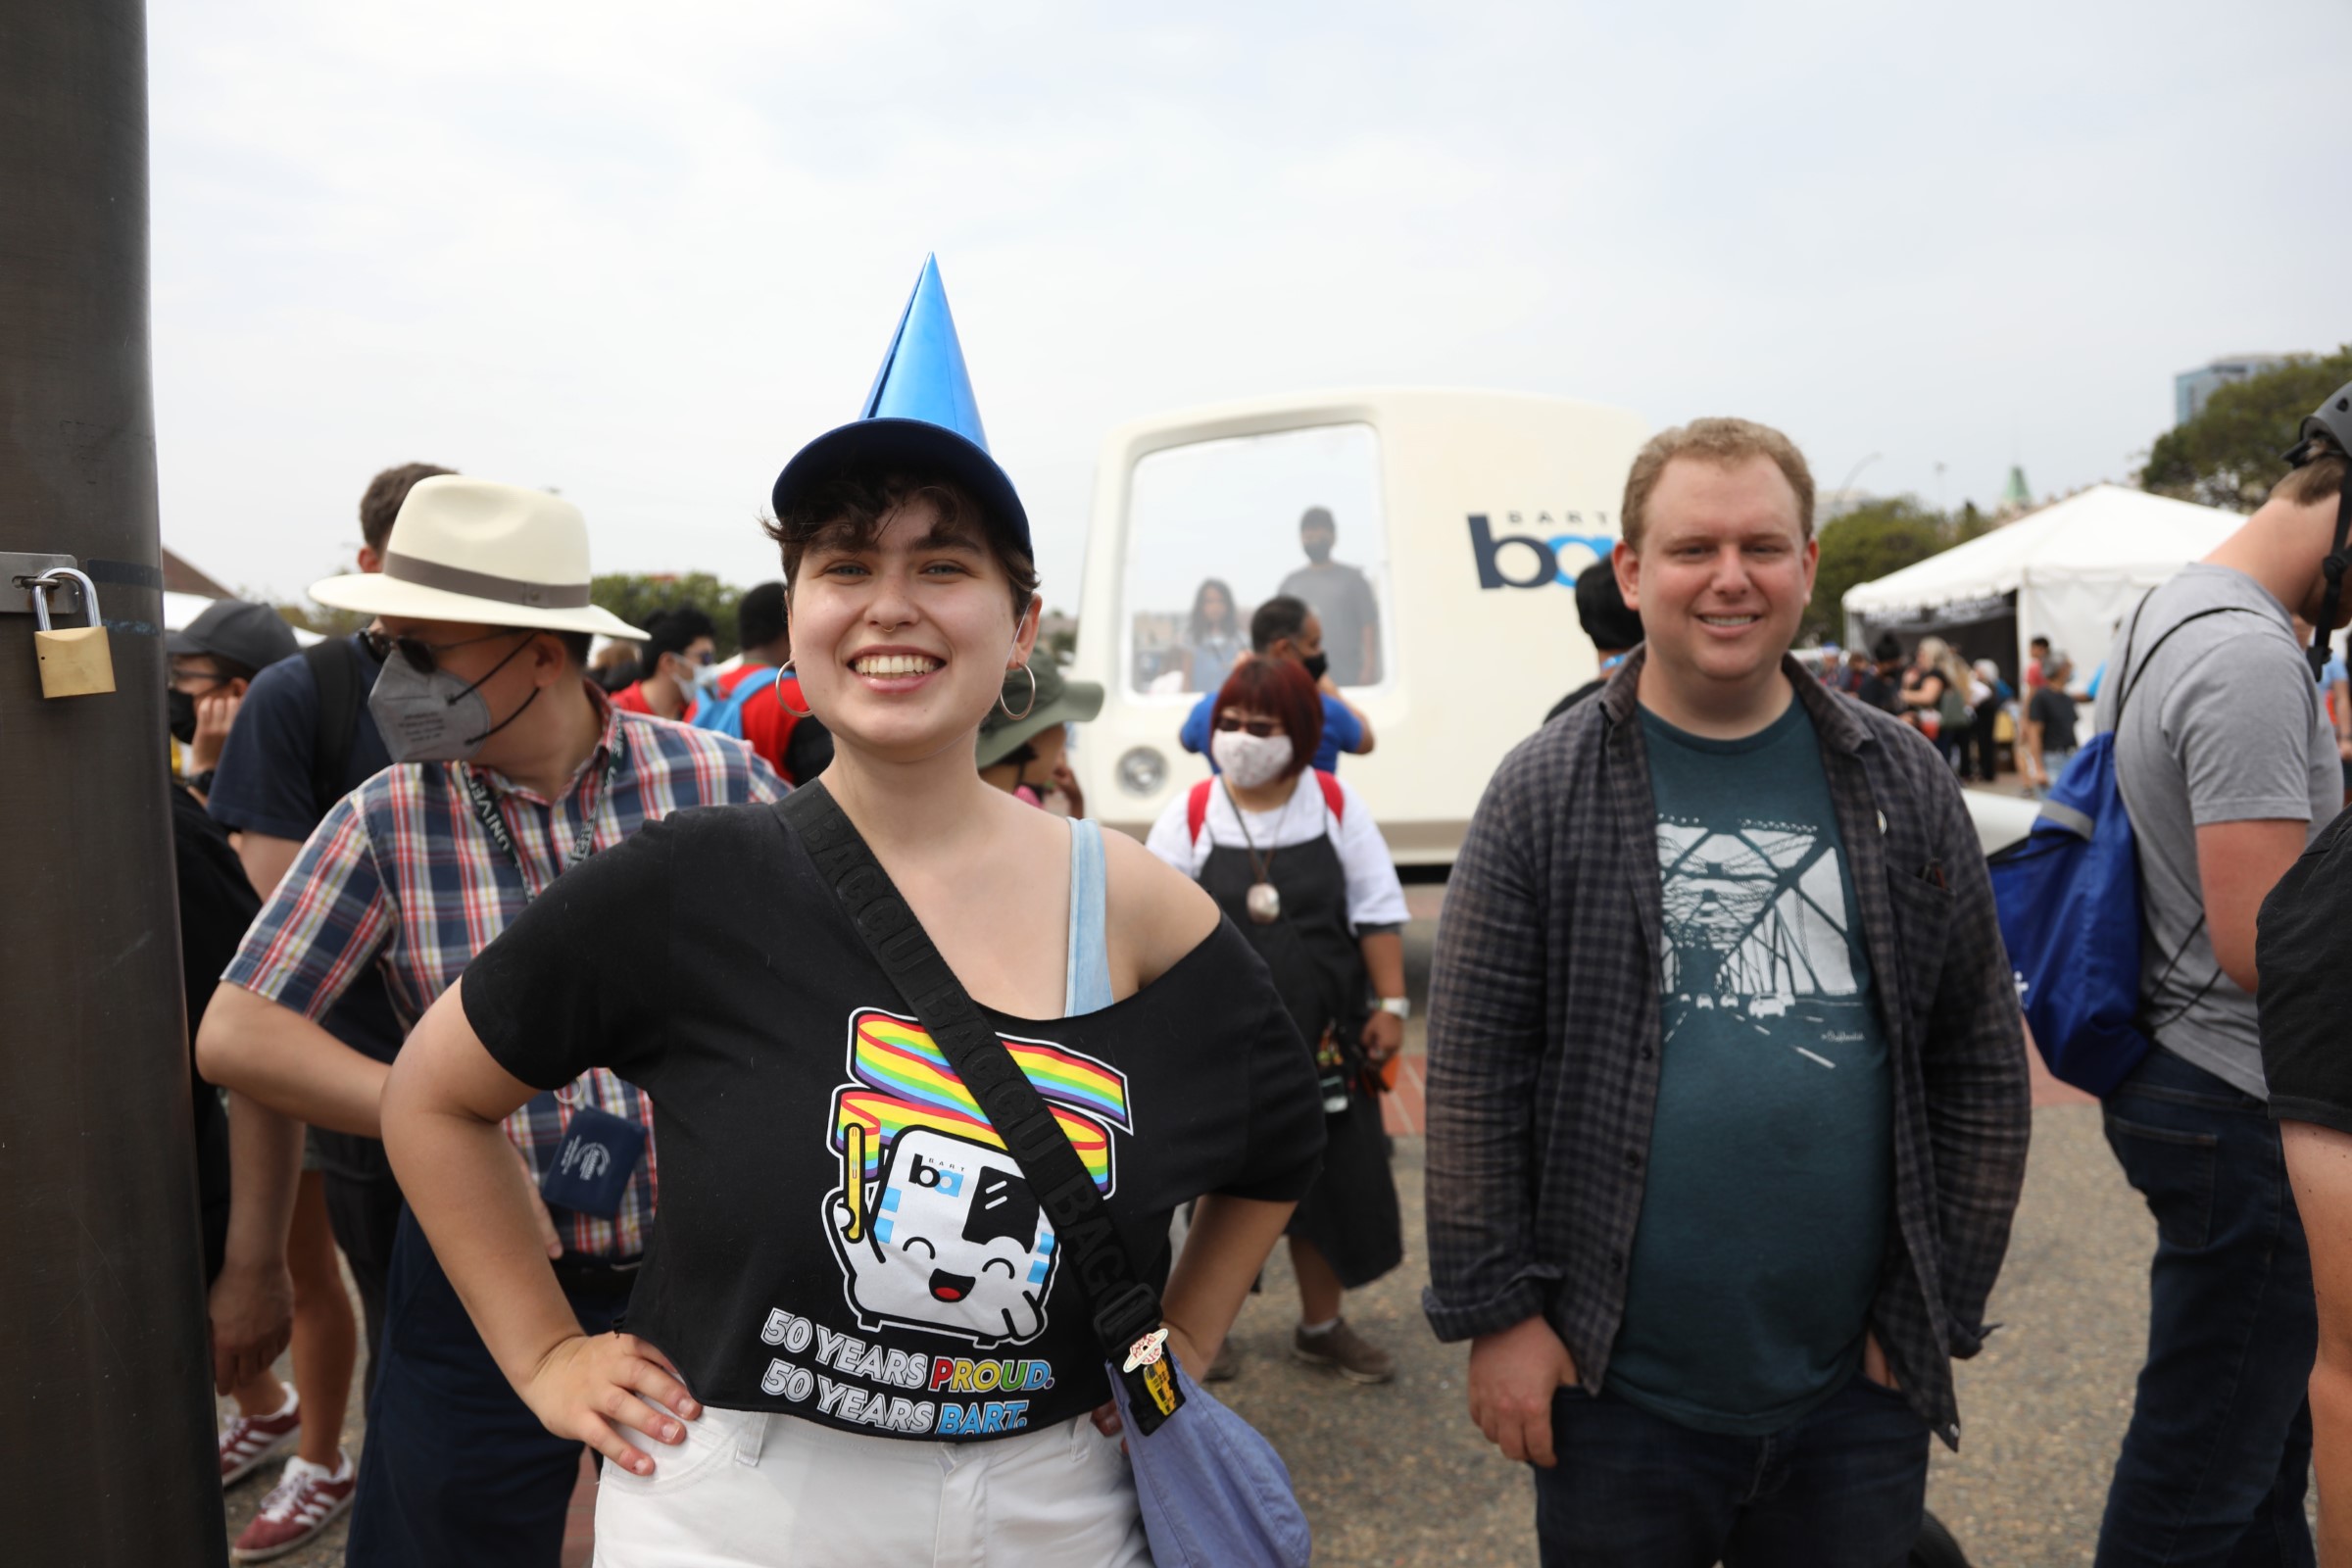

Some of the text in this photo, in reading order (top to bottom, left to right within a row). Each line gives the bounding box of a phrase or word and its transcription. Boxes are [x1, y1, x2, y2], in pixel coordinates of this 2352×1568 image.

[1508, 511, 1608, 525] BART
[760, 1307, 1055, 1393] 50 YEARS PROUD.
[760, 1358, 1030, 1435] 50 YEARS BART.
